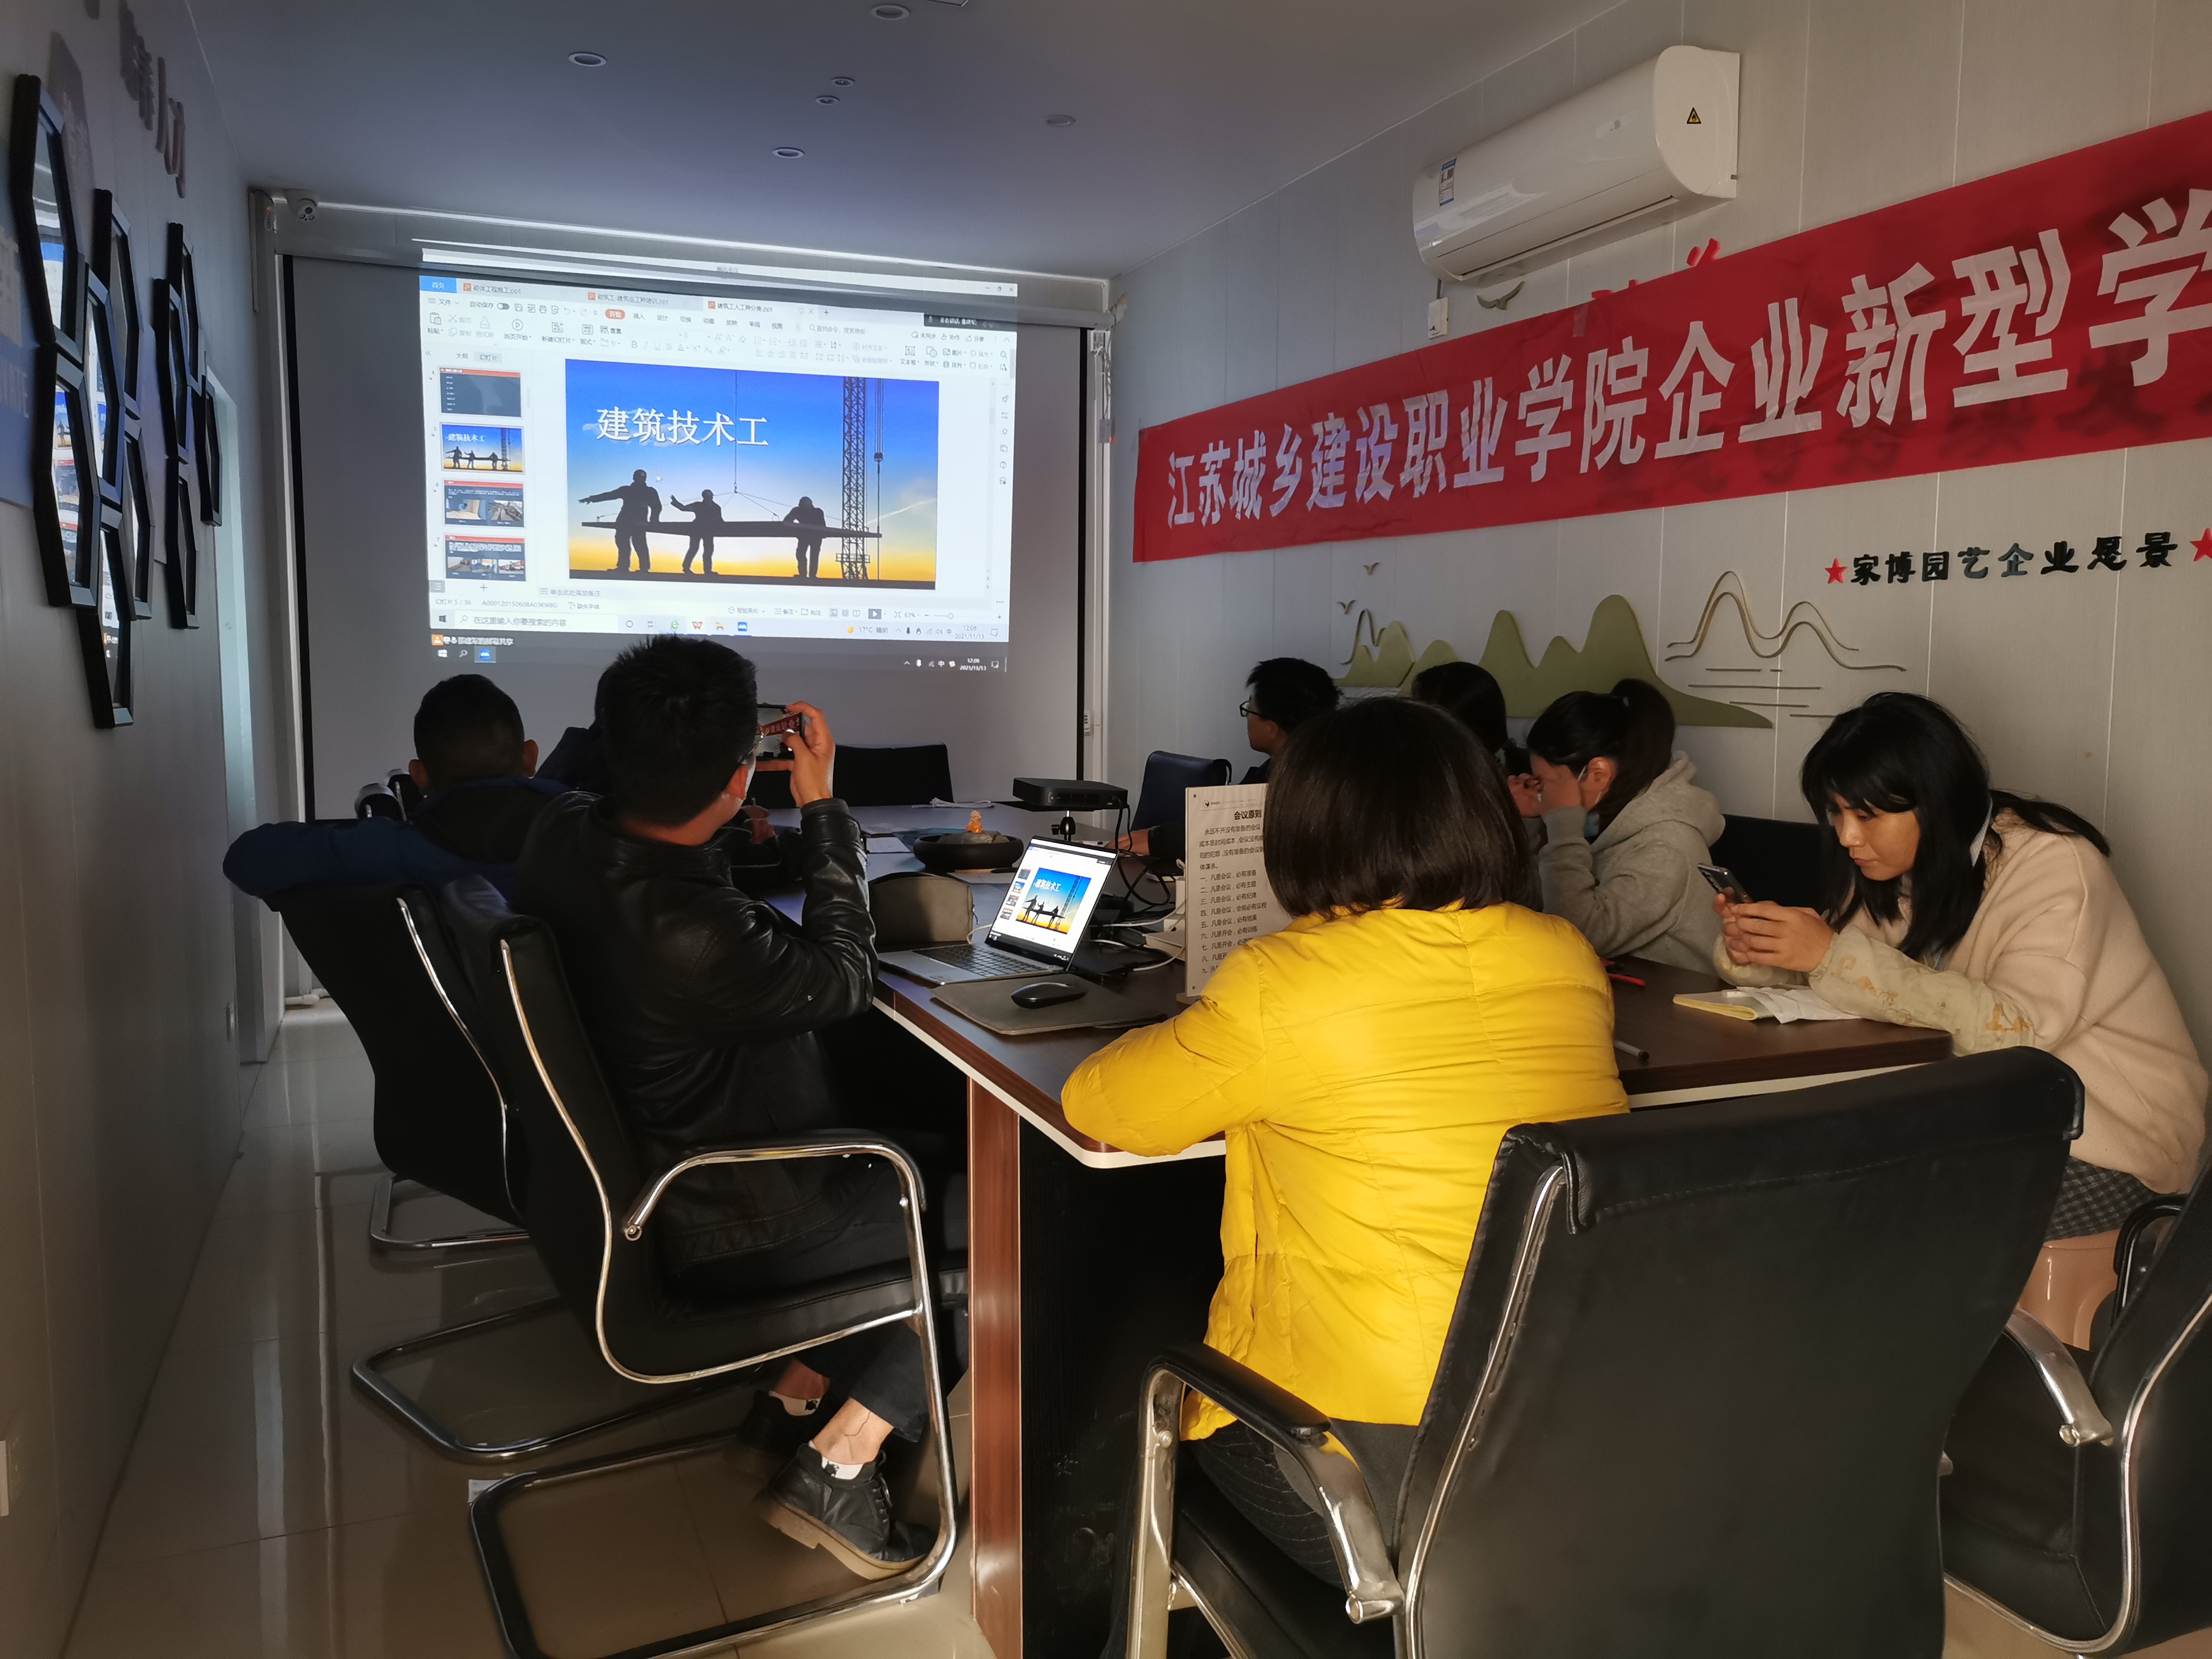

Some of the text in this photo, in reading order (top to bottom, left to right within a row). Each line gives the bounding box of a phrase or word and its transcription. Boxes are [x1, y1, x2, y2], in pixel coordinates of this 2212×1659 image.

[1167, 189, 2212, 529] 江苏城乡建设职业学院企业新型学
[597, 406, 769, 446] 建筑技术工
[447, 433, 485, 442] 建筑技术工
[1850, 532, 2178, 586] 家博园艺企业愿景
[474, 616, 567, 627] 在这里输入你要搜索的内容
[1233, 808, 1262, 820] 会议原则
[1034, 879, 1062, 892] 建筑技术工
